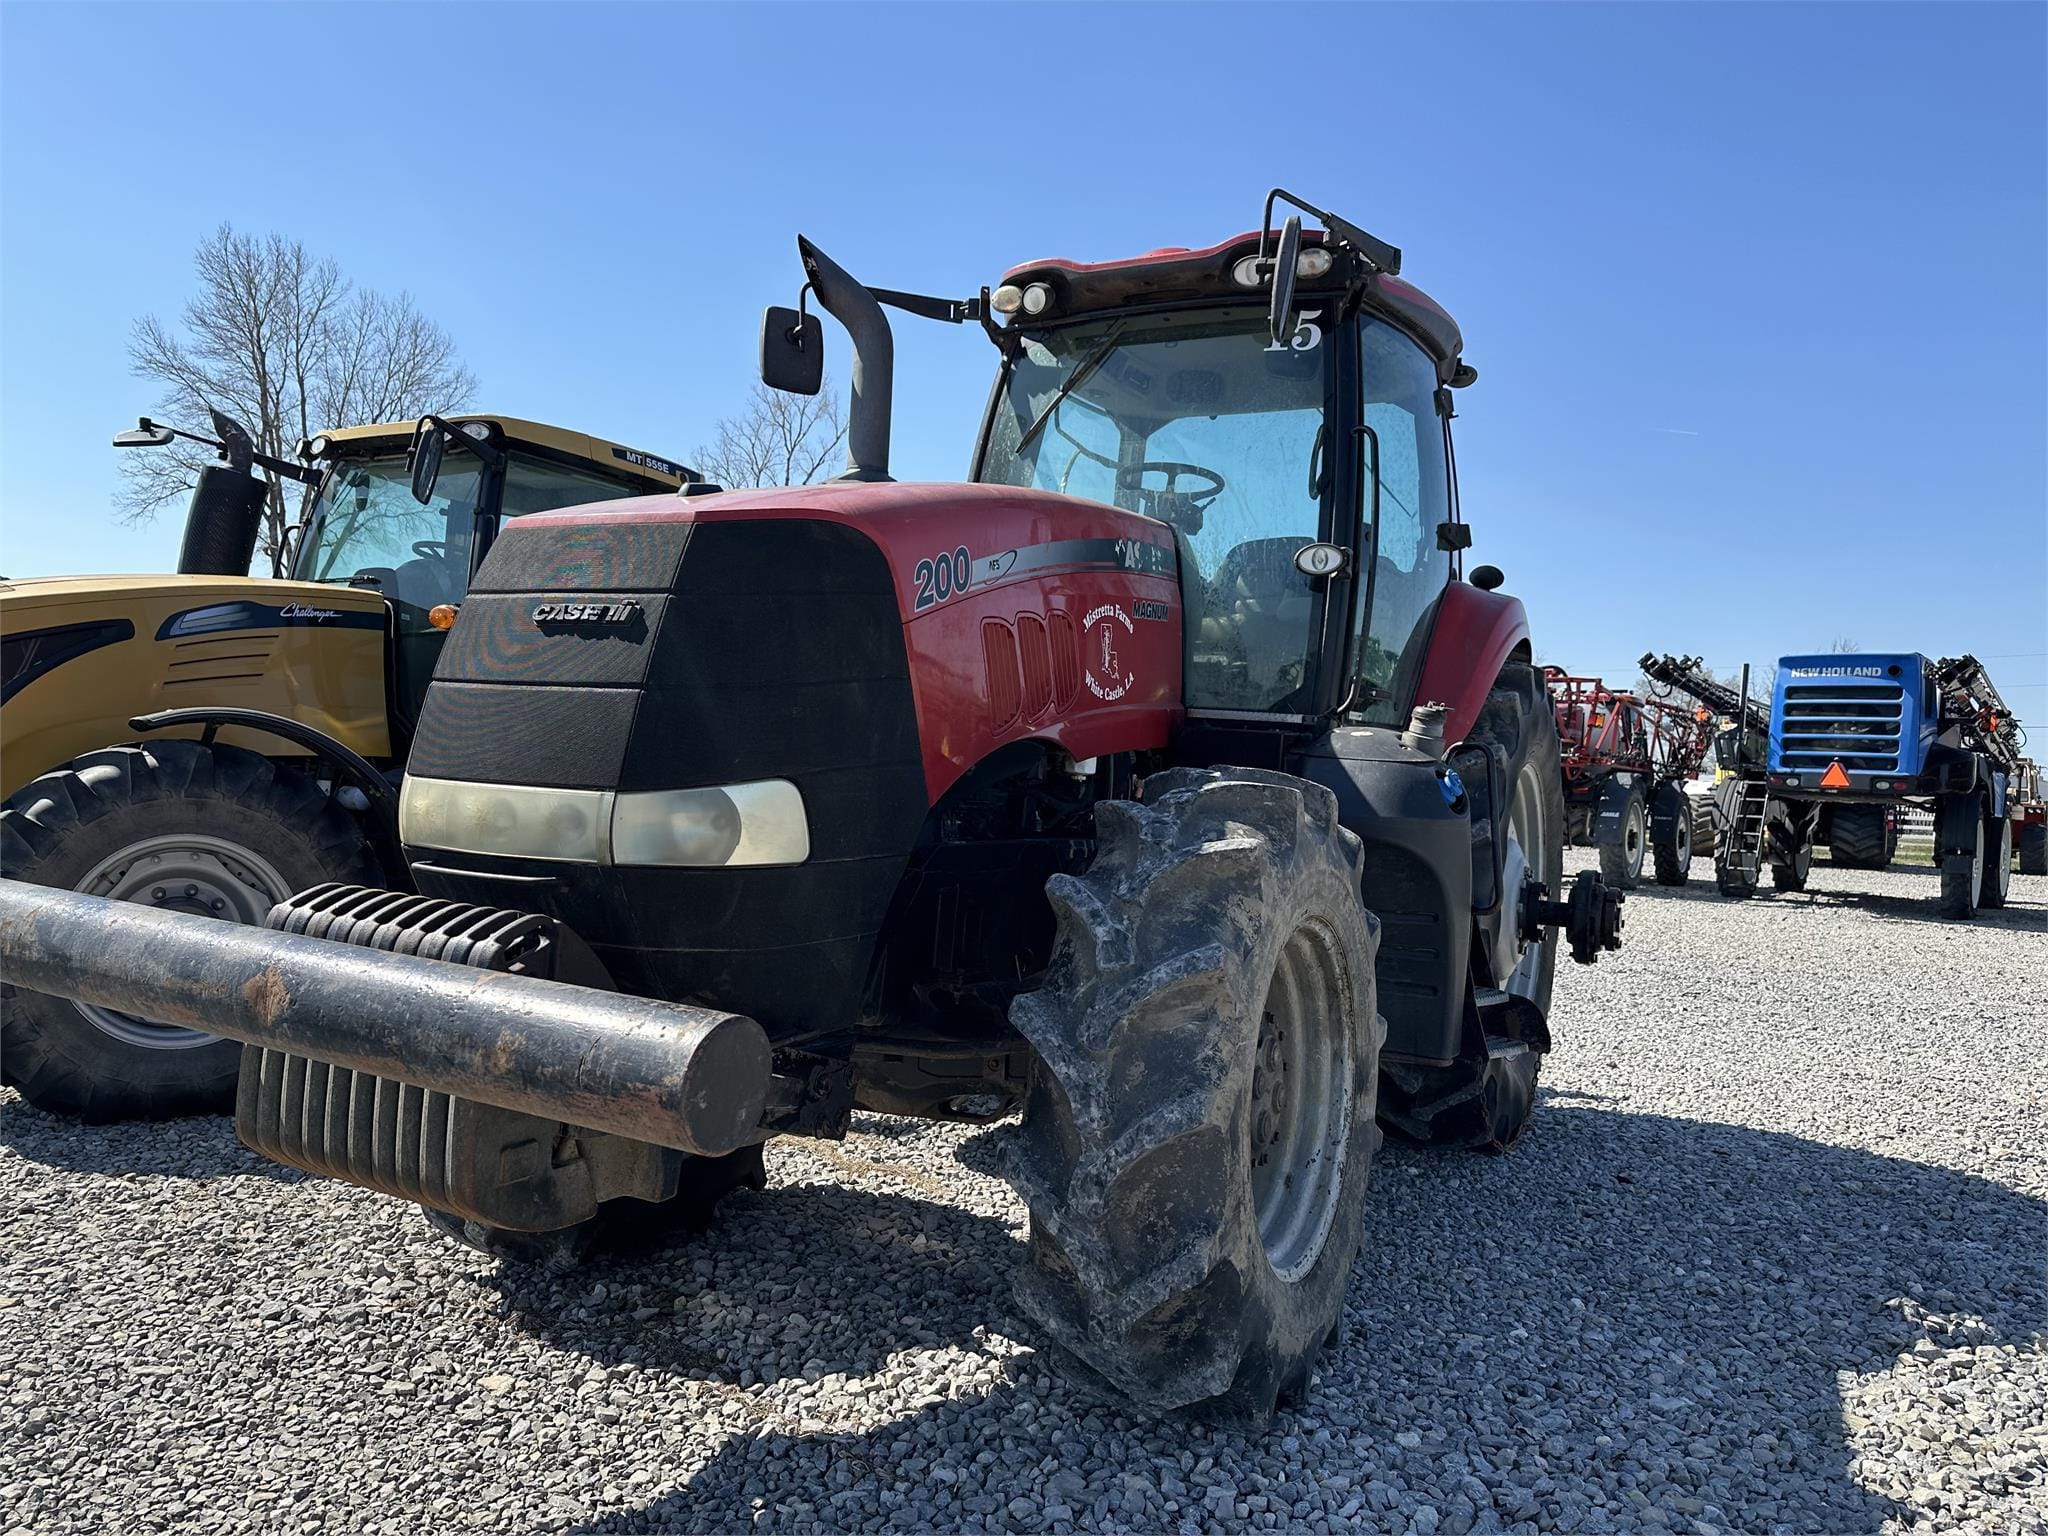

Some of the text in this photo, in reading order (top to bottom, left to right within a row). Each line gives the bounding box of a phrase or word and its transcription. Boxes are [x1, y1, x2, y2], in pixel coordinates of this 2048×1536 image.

[626, 451, 670, 473] MT 555E
[914, 545, 971, 613] 200
[280, 602, 343, 622] Challenger
[532, 603, 602, 621] CASE
[1083, 604, 1134, 634] Mistretta Farms
[1132, 599, 1169, 622] MAGNUM
[1791, 667, 1882, 678] NEW HOLLAND
[1085, 669, 1103, 699] White
[1125, 672, 1135, 690] LA
